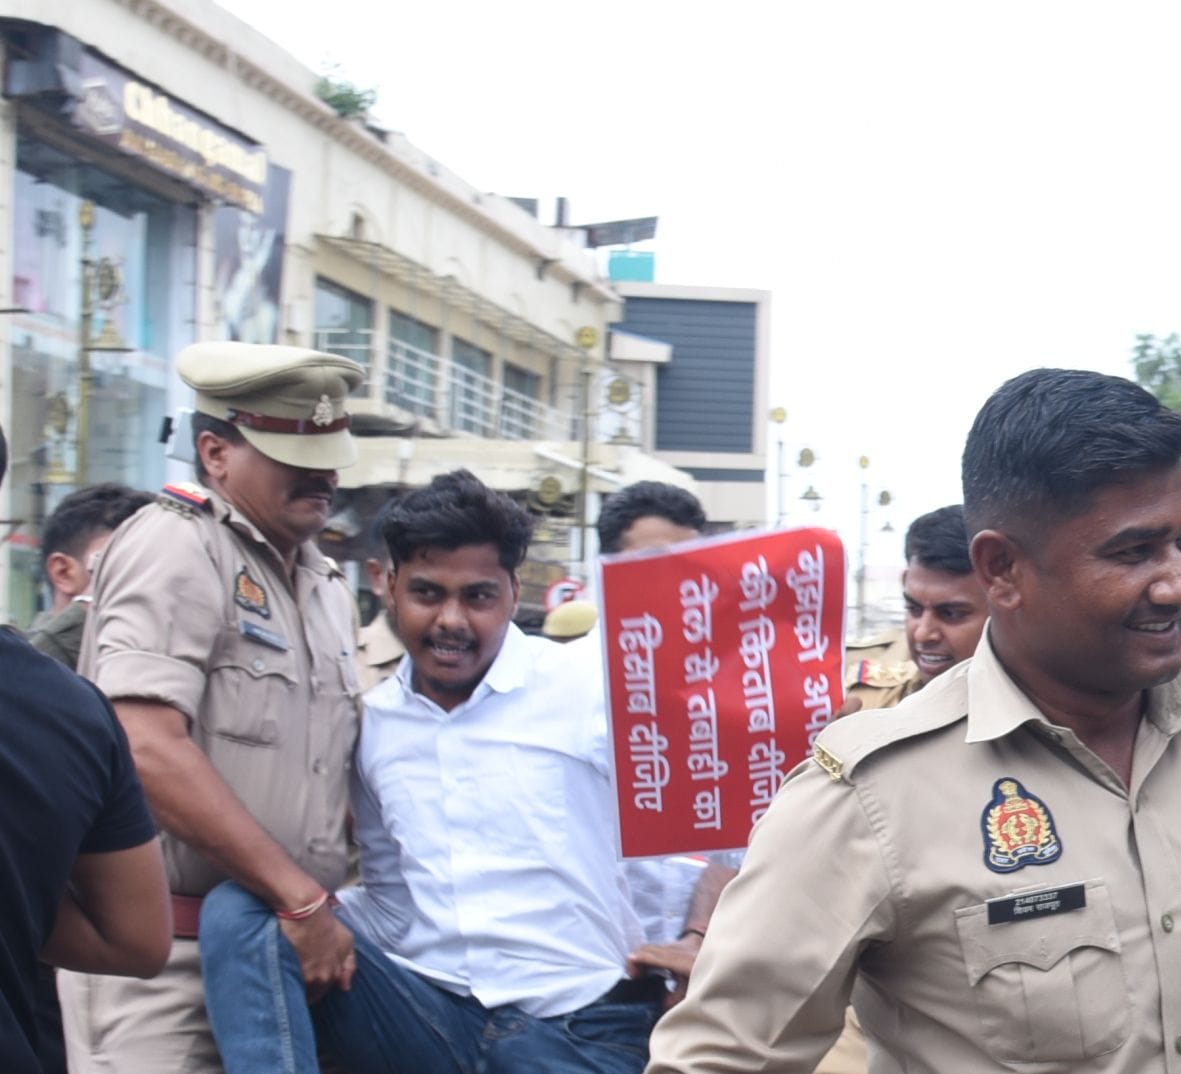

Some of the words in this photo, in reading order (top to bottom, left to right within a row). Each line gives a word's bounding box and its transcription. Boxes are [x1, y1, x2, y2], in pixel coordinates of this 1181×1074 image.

[679, 574, 719, 643] तेल
[738, 555, 778, 611] की
[786, 544, 829, 663] मुझको
[618, 612, 663, 715] हिसाब
[684, 648, 720, 684] से
[738, 615, 776, 734] किताब
[628, 723, 670, 813] दीजिए
[686, 688, 729, 781] तबाही
[693, 786, 721, 830] का
